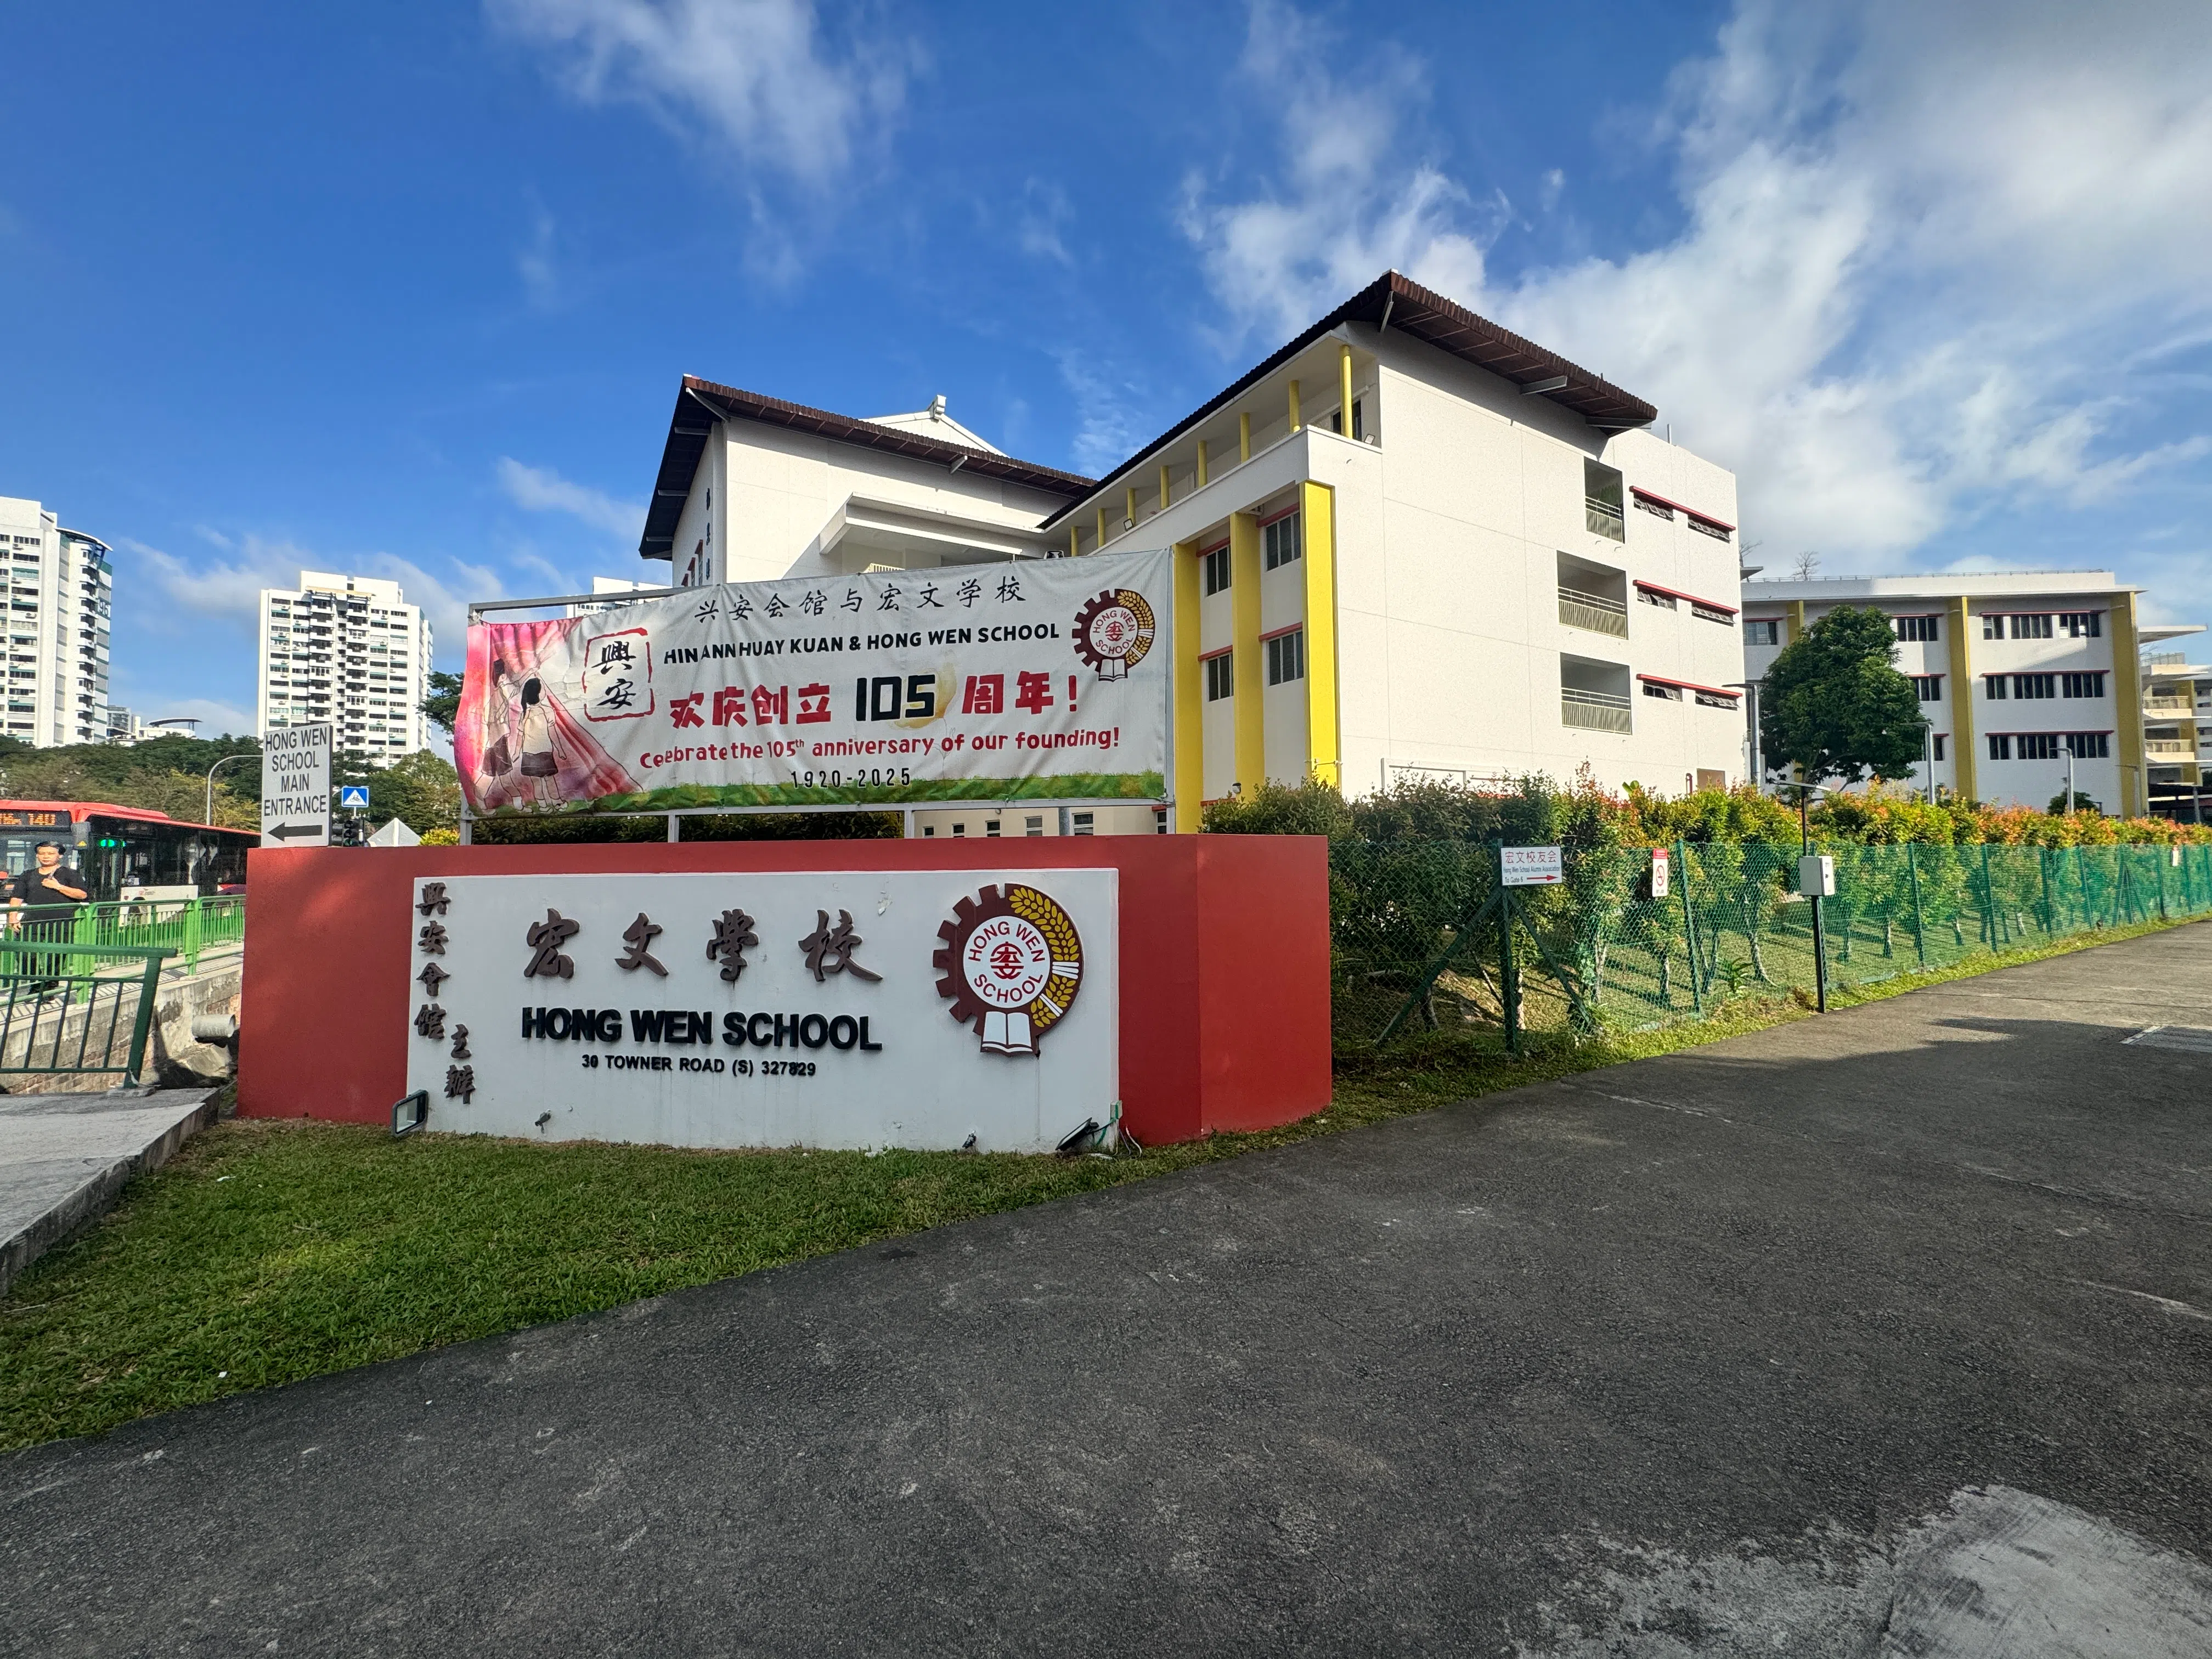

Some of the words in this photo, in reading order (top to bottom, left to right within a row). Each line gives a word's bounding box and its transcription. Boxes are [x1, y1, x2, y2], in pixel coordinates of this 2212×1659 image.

[695, 575, 1026, 623] 兴安会馆与宏文学校
[1093, 610, 1117, 633] HONG
[1120, 610, 1136, 631] WEN
[791, 636, 843, 653] KUAN
[849, 636, 861, 651] &
[867, 632, 921, 650] HONG
[928, 628, 972, 645] WEN
[978, 623, 1060, 643] SCHOOL
[1096, 637, 1133, 654] SCHOOL
[591, 640, 636, 710] 興安
[669, 683, 831, 729] 欢庆创立
[856, 674, 936, 721] 105
[266, 731, 297, 752] HONG
[301, 727, 327, 747] WEN
[731, 742, 763, 759] the
[767, 739, 804, 758] 105th
[812, 737, 934, 757] anniversary
[941, 733, 965, 752] of
[972, 734, 1008, 749] our
[1015, 726, 1119, 751] founding!
[272, 751, 319, 772] SCHOOL
[281, 773, 309, 793] MAIN
[791, 768, 911, 788] 1920-2025
[264, 795, 326, 816] ENTRANCE
[1505, 850, 1556, 864] 宏文校友会
[524, 908, 884, 982] 宏文學校
[968, 921, 1010, 962] HONG
[1015, 923, 1045, 962] WEN
[974, 974, 1043, 1003] SCHOOL
[522, 1007, 622, 1040] HONG
[630, 1010, 713, 1044] WEN
[722, 1011, 883, 1051] SCHOOL
[605, 1054, 673, 1071] TOWNER
[679, 1058, 725, 1073] ROAD
[732, 1059, 754, 1077] (S)
[761, 1060, 816, 1076] 327829
